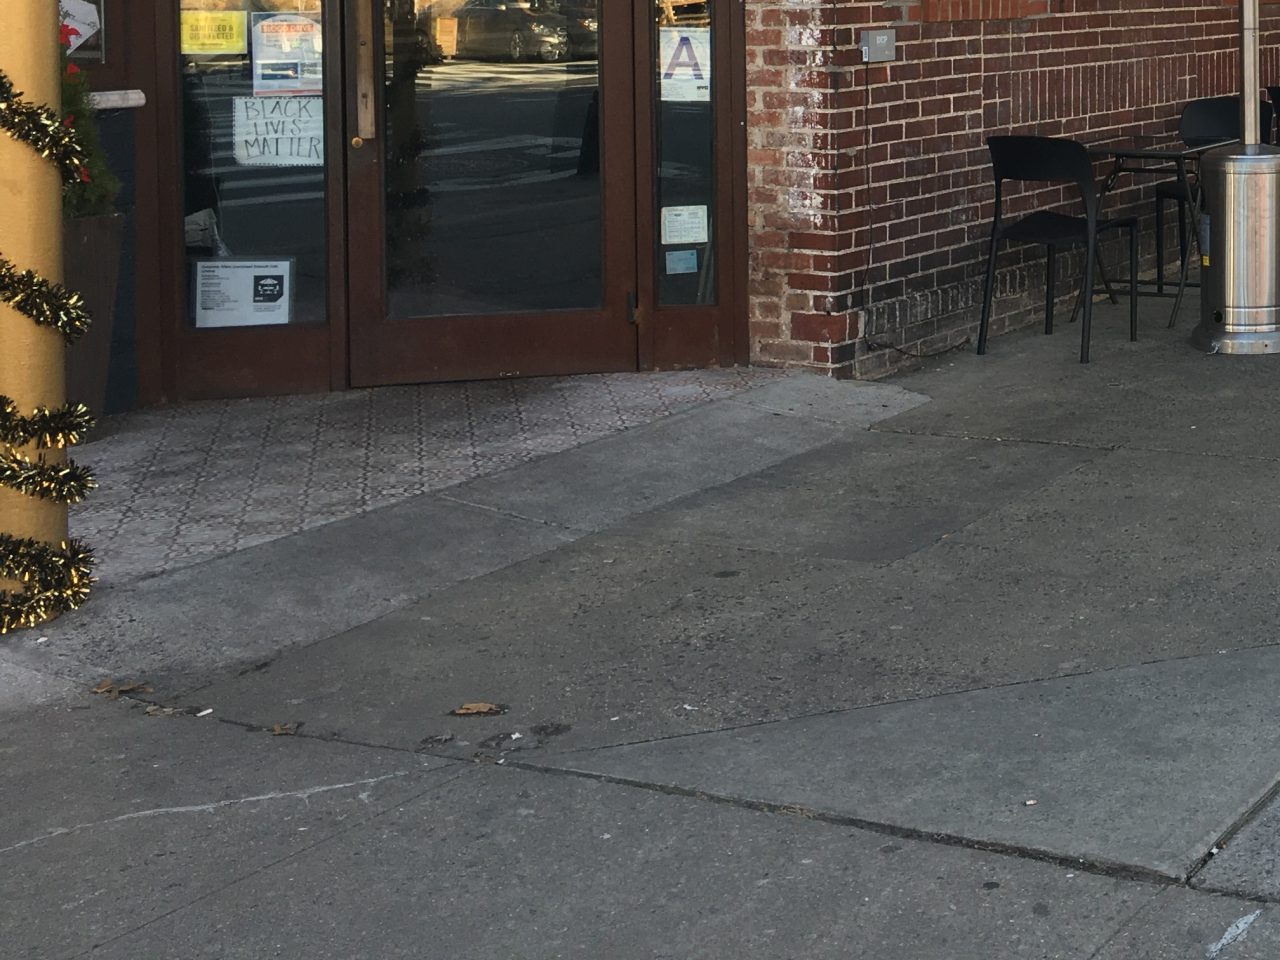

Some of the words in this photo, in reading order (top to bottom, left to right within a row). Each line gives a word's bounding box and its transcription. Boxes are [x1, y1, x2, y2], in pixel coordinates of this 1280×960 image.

[189, 24, 227, 32] SANTIZED
[189, 32, 234, 40] DISFECTED
[663, 36, 704, 80] A
[244, 99, 313, 120] BLACK
[244, 136, 321, 160] MATTER
